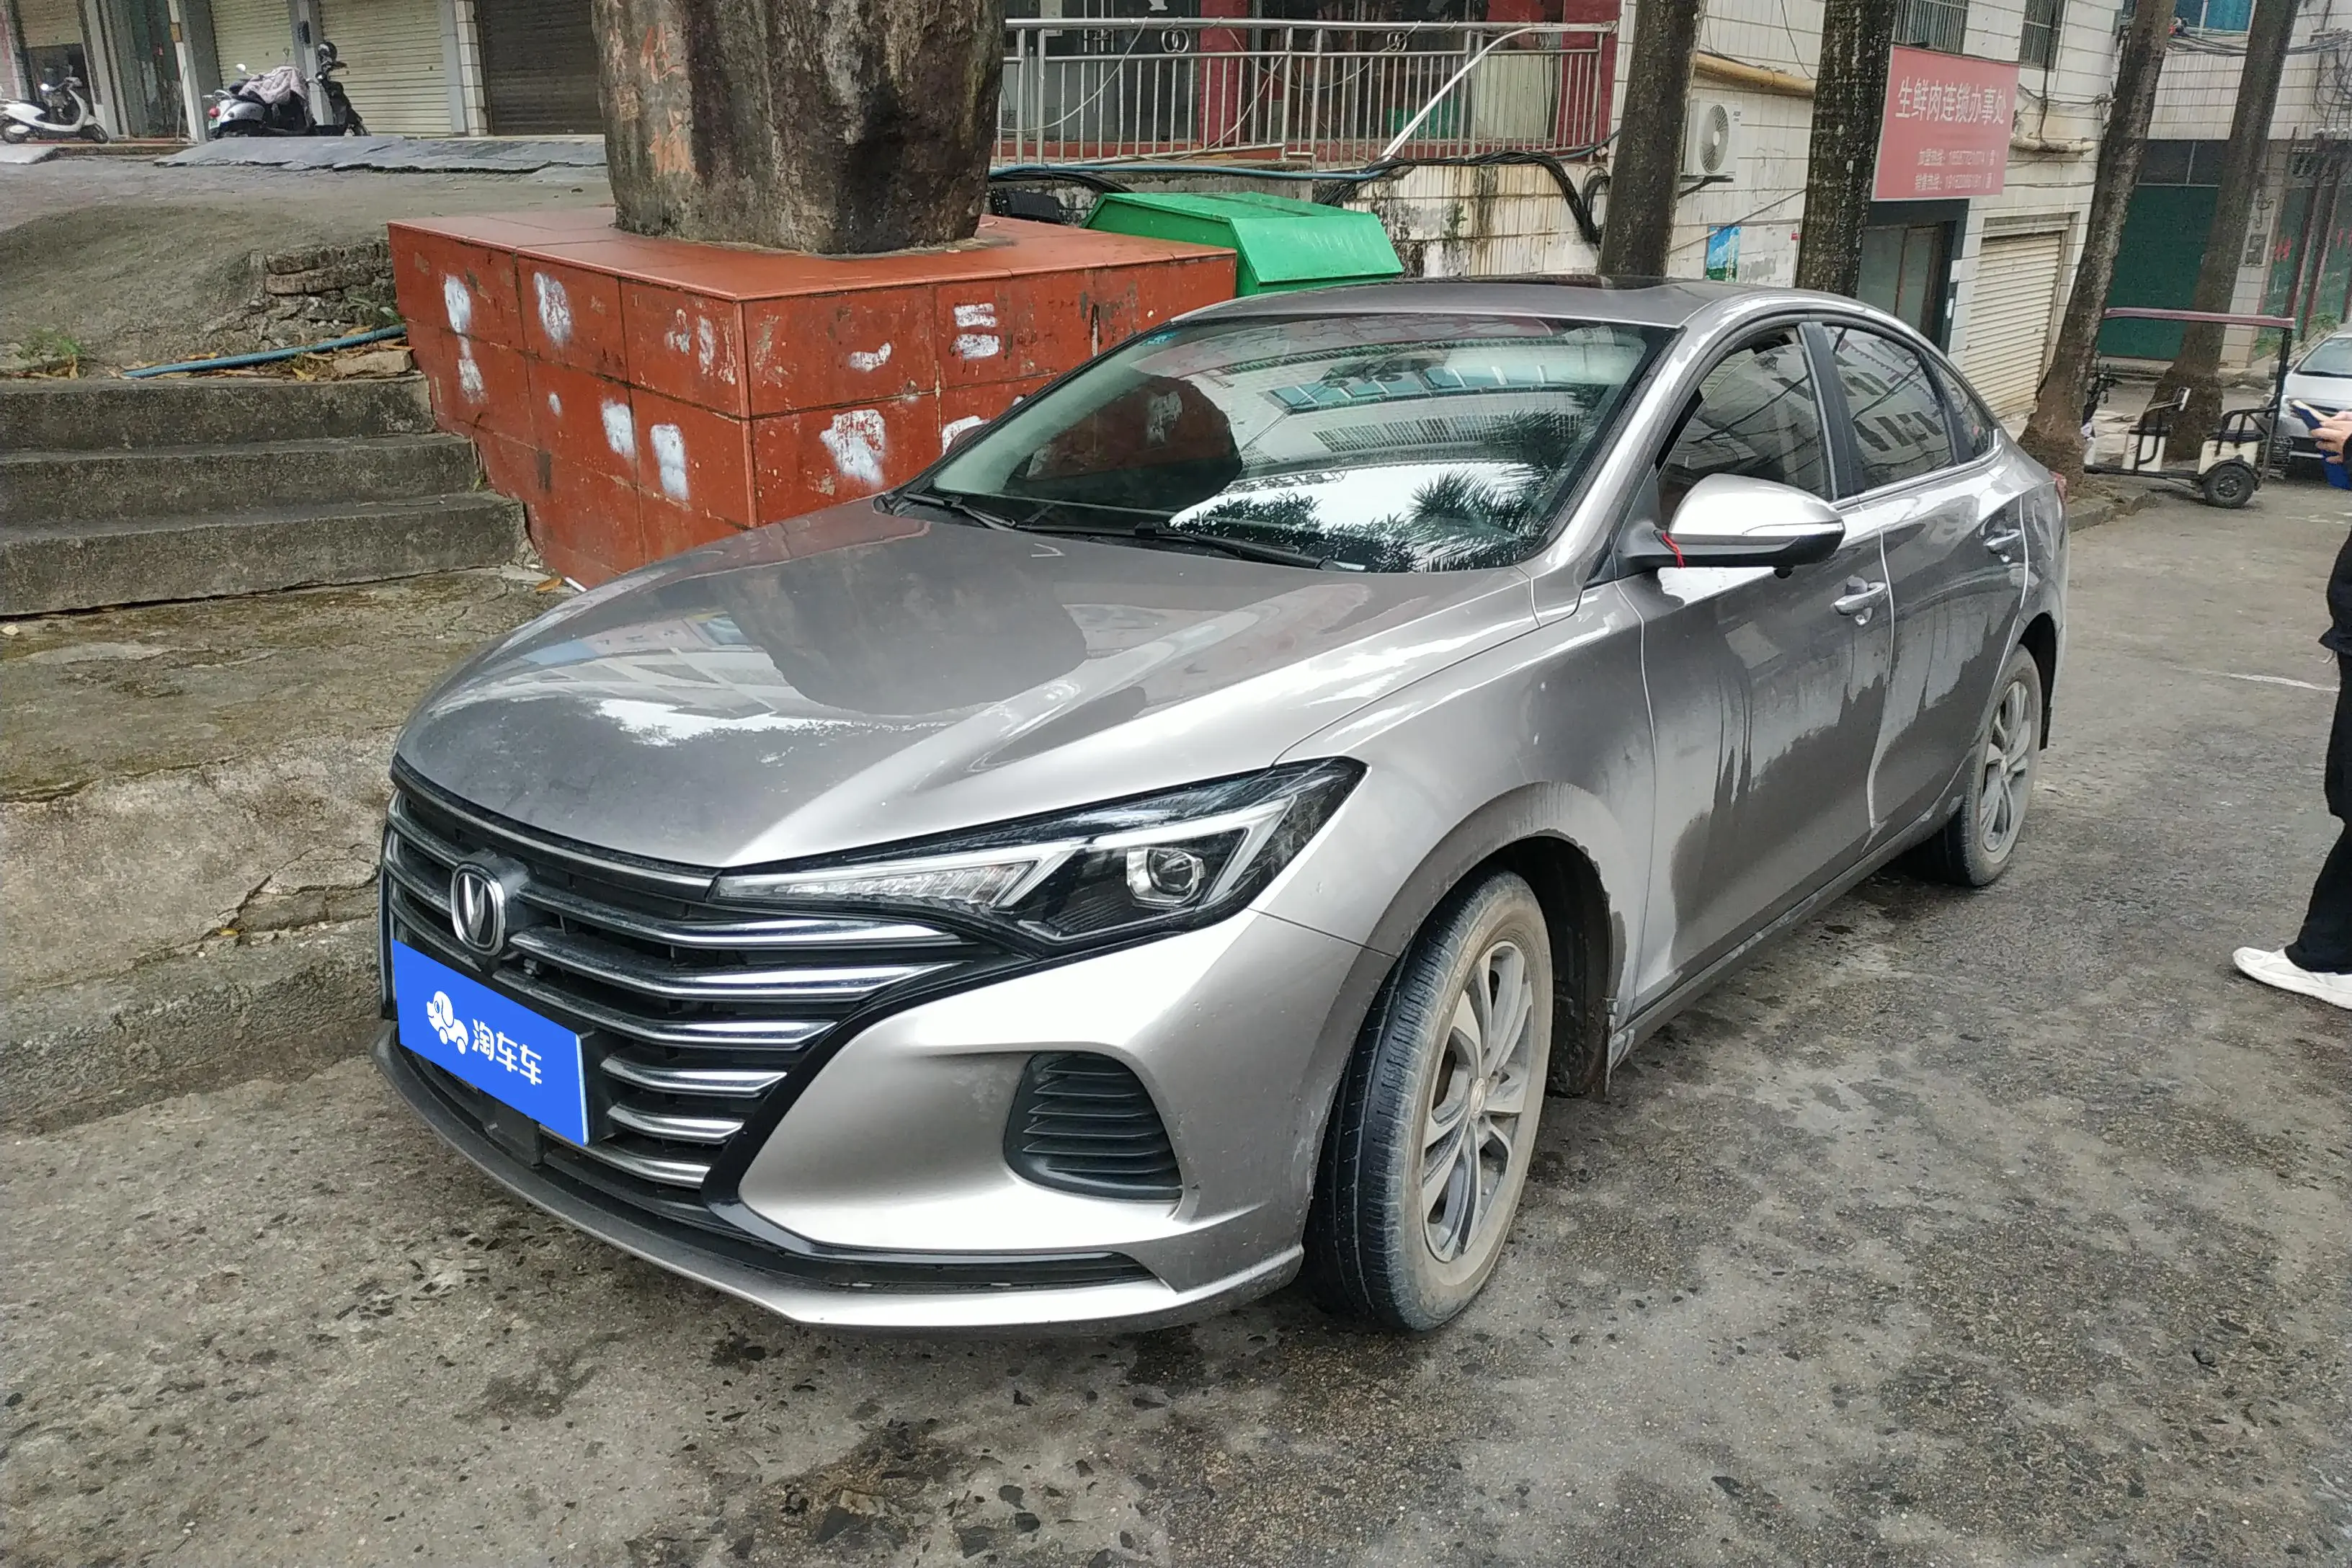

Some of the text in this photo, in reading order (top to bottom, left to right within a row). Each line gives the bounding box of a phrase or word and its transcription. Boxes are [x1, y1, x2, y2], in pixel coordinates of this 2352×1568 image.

[1895, 76, 2007, 125] 生鲜肉连锁办事处
